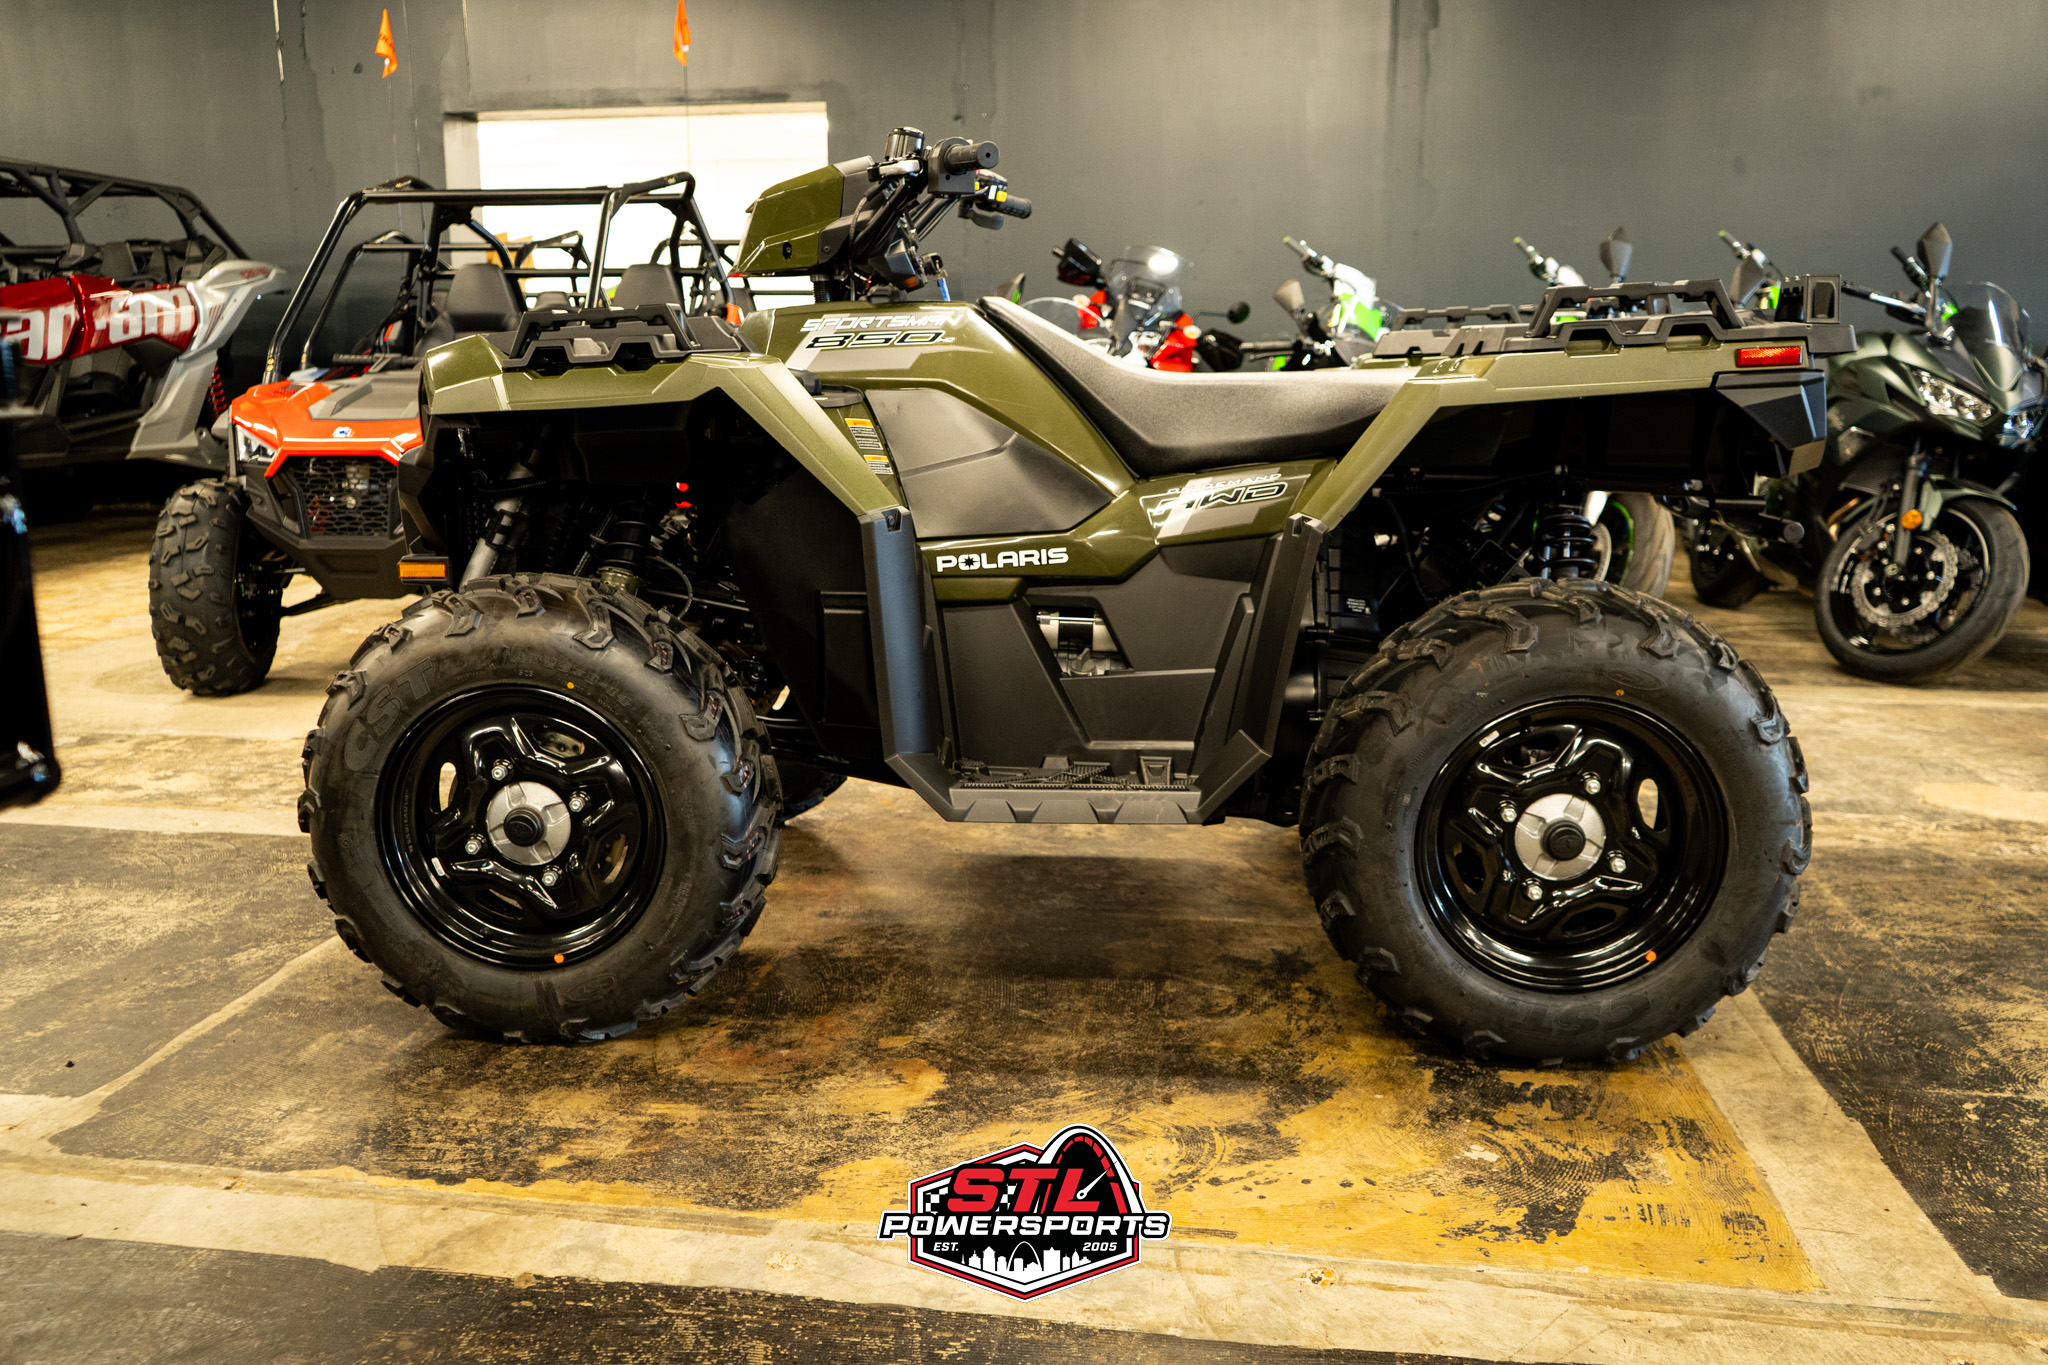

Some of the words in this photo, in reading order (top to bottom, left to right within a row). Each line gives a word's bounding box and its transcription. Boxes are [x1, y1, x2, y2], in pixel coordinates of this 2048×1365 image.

[0, 287, 195, 361] an-am
[800, 313, 961, 332] SPORTSMAN
[804, 330, 946, 349] 850
[936, 546, 1069, 573] POLARIS
[344, 656, 433, 771] CST
